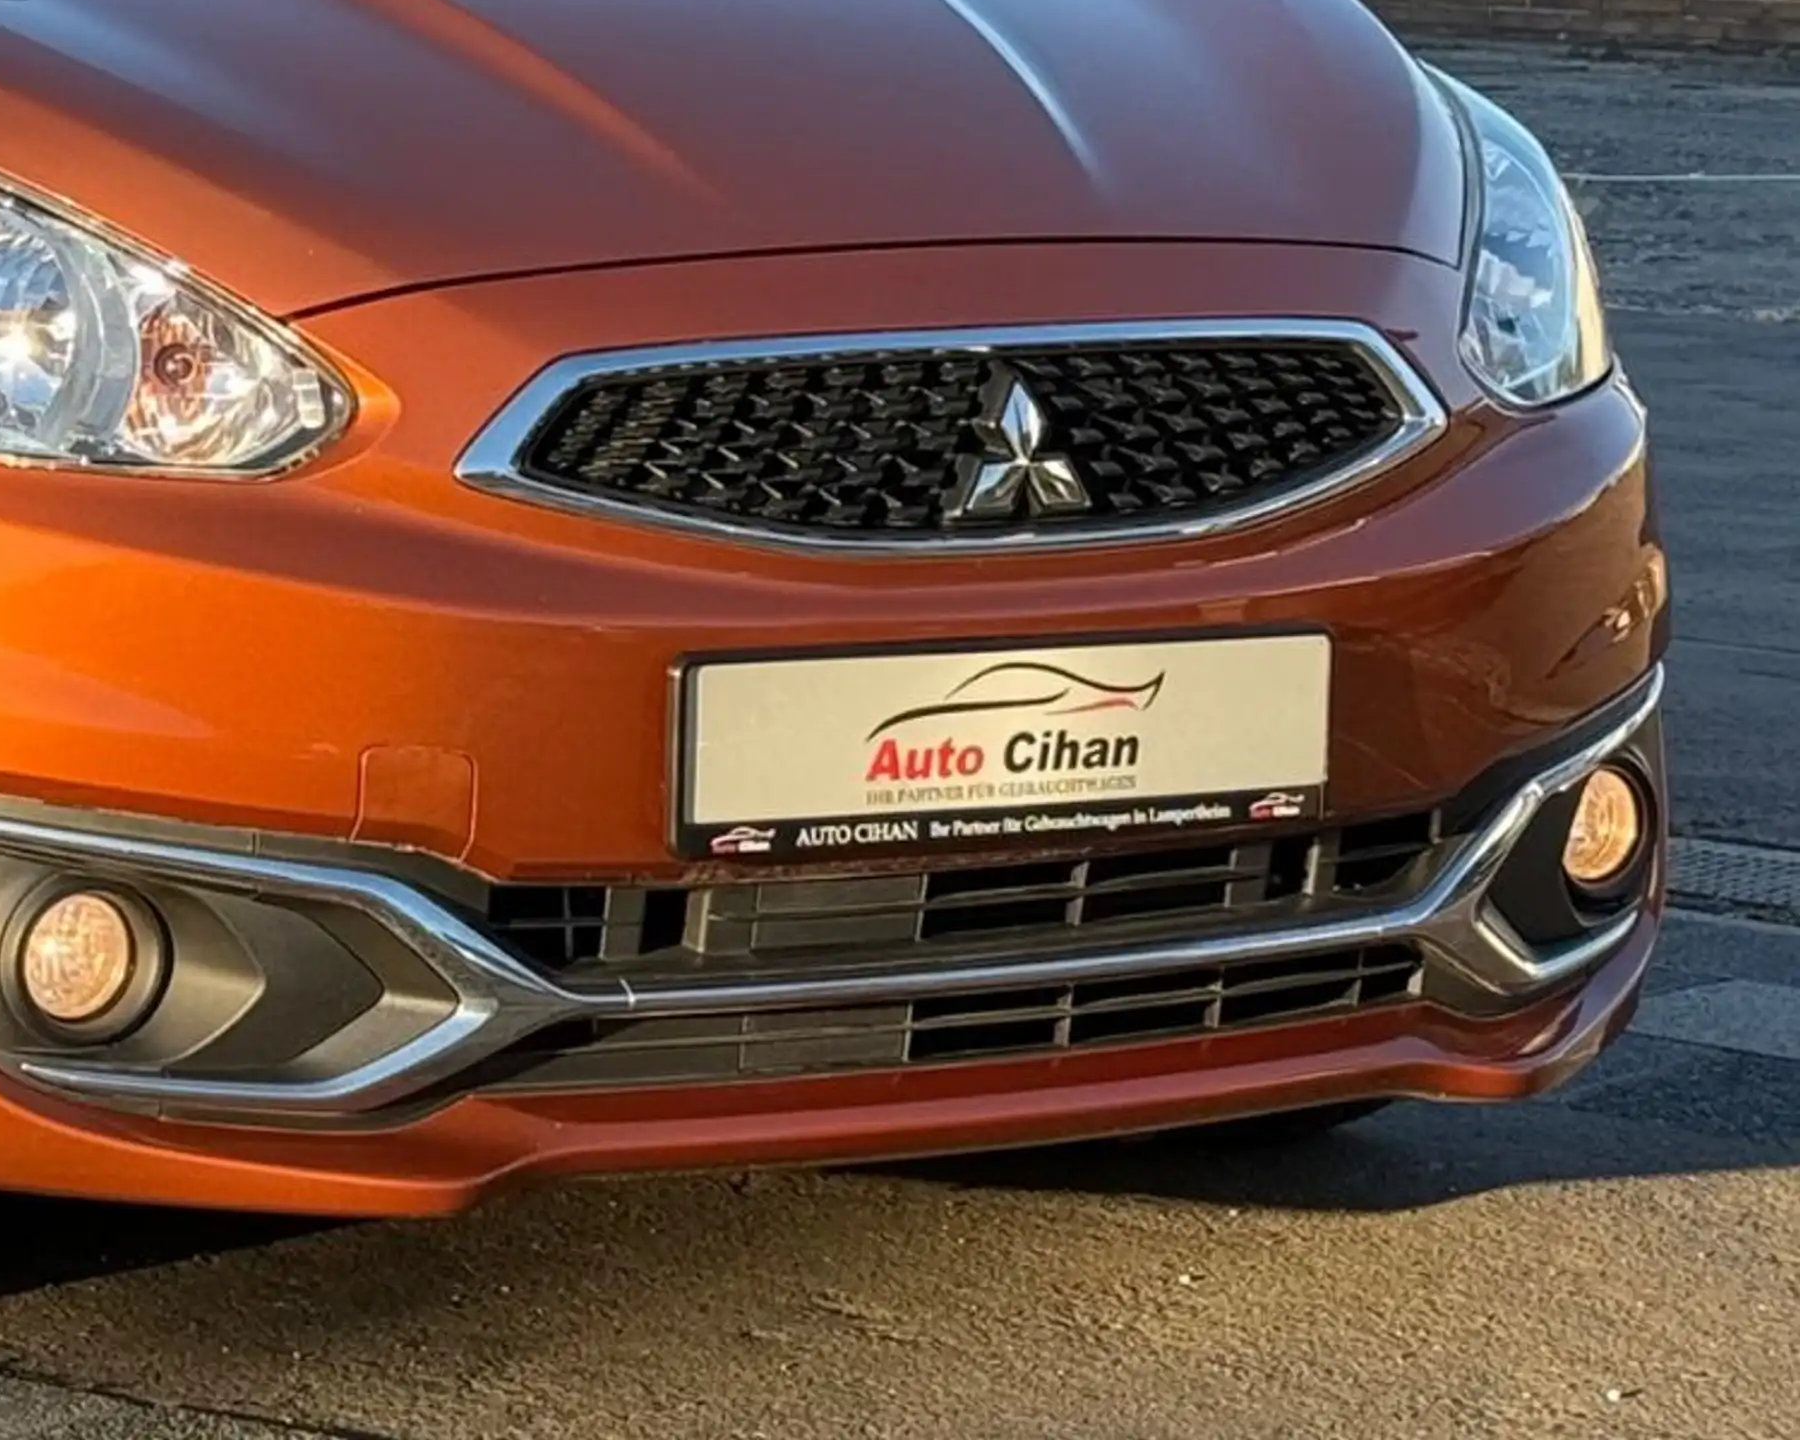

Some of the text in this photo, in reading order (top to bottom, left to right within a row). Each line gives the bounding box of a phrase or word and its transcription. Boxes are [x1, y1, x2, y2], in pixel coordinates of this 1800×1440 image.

[864, 730, 1140, 782] Auto Cihan
[796, 824, 851, 847] AUTO
[854, 821, 918, 844] CIHAN
[953, 819, 1000, 836] Partner
